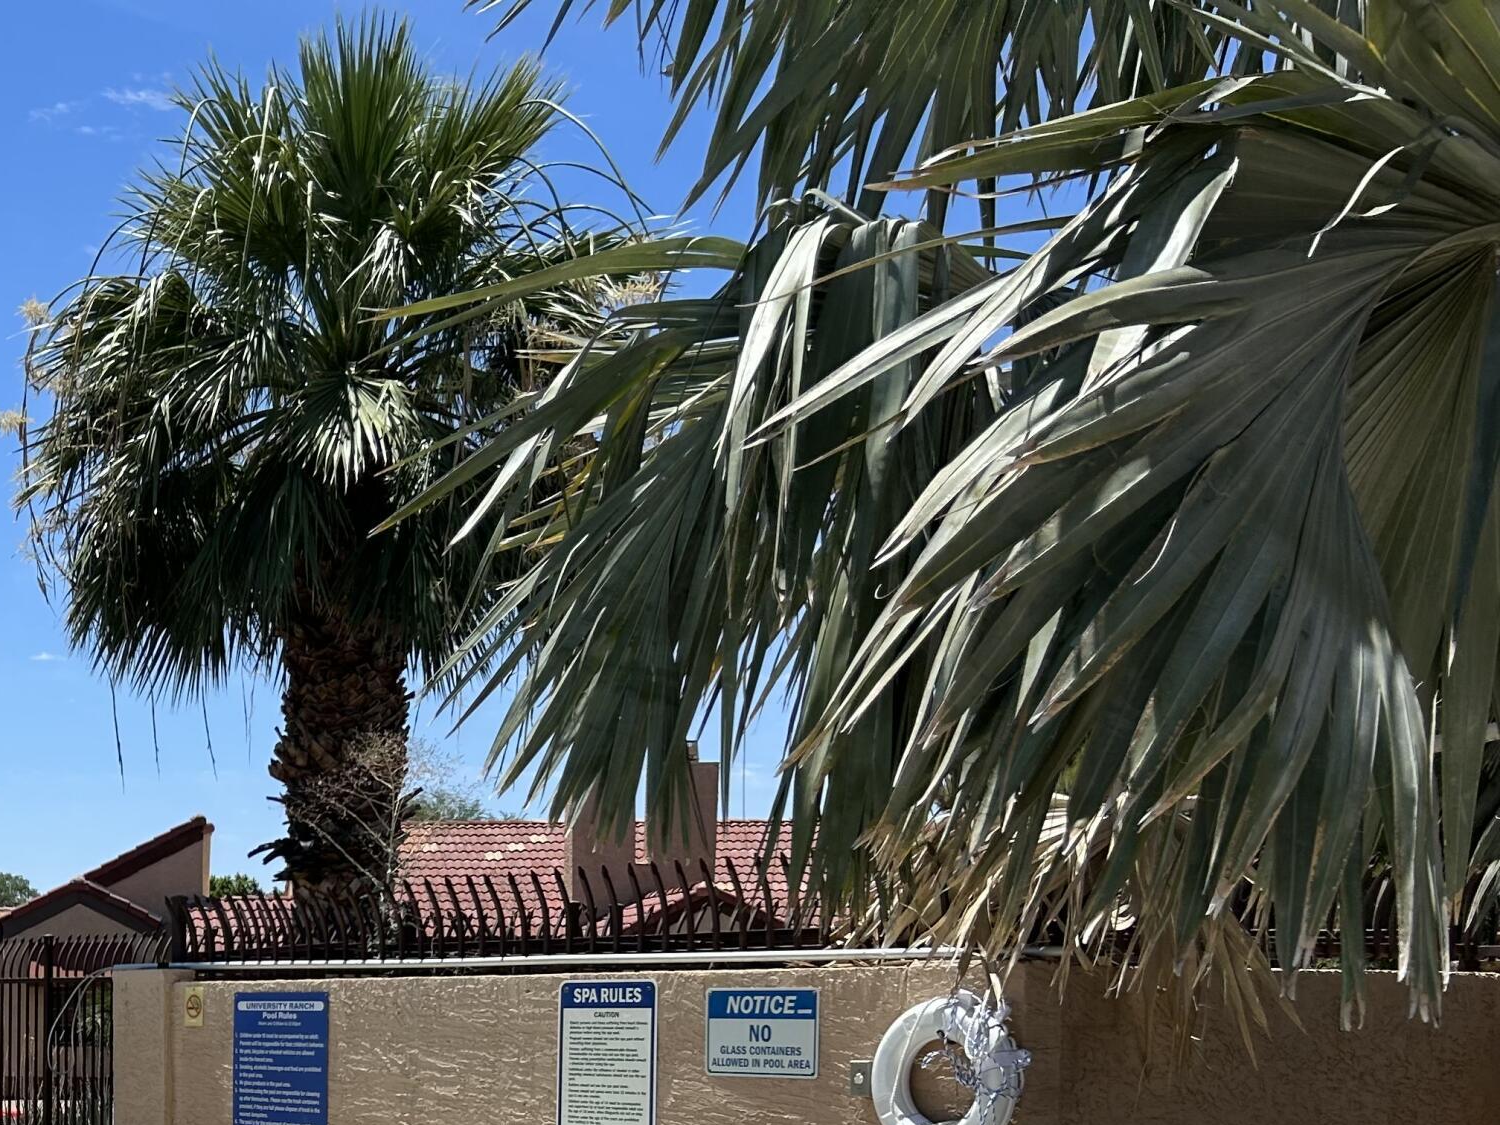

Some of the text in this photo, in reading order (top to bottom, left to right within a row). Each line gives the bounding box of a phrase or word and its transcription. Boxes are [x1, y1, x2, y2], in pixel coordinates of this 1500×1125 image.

[573, 987, 642, 1003] SPA RULES
[246, 1002, 315, 1010] UNIVERSITY RANCH
[726, 995, 797, 1014] NOTICE
[262, 1011, 297, 1020] Pool Rules
[749, 1024, 772, 1042] NO
[720, 1045, 802, 1056] GLASS CONTAINERS
[711, 1058, 811, 1069] ALLOWED IN POOL AREA
